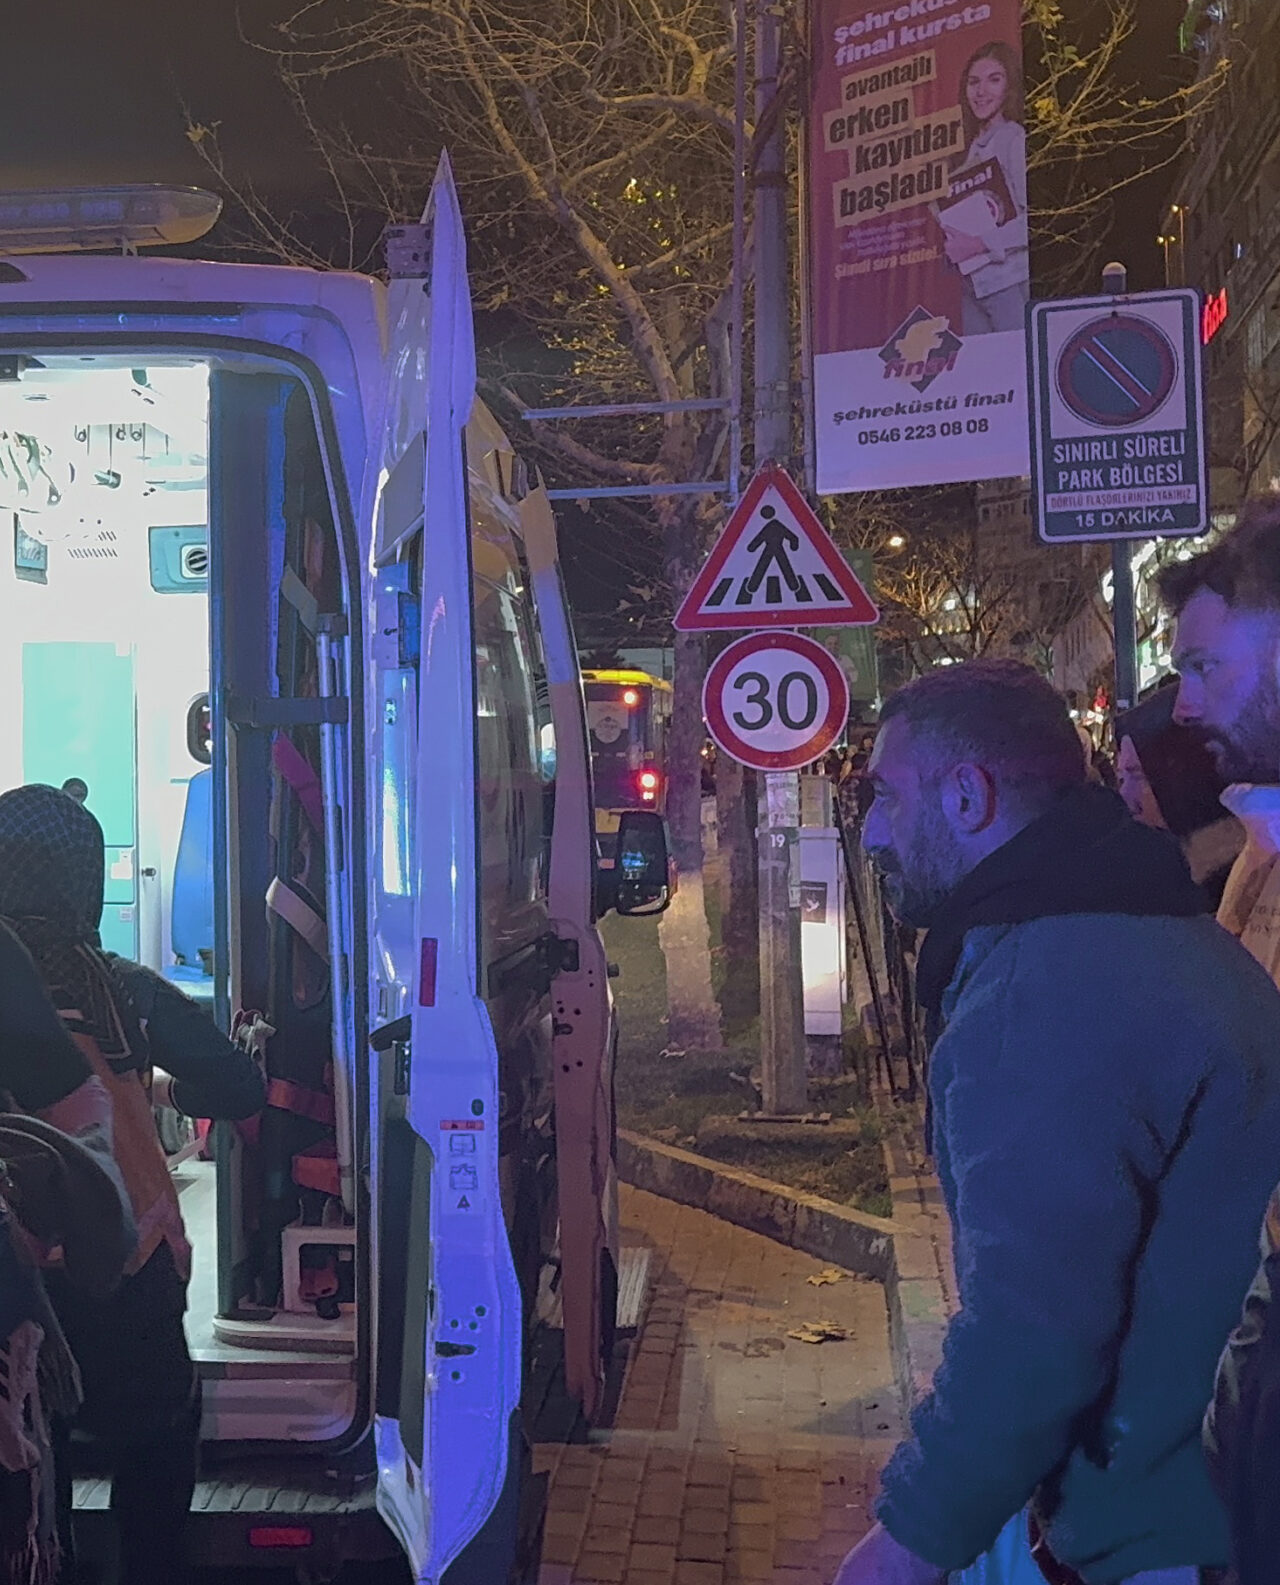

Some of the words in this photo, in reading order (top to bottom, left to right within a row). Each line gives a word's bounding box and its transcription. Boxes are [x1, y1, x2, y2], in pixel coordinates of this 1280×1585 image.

[834, 30, 895, 66] final
[900, 4, 991, 45] kursta
[845, 55, 932, 101] avantajlı
[829, 97, 909, 144] erken
[855, 118, 961, 174] kayıtlar
[839, 163, 942, 218] başladı
[883, 351, 959, 379] final
[833, 396, 958, 425] şehreküstü
[964, 389, 1015, 408] final
[858, 428, 901, 445] 0546
[904, 425, 936, 441] 223
[940, 421, 962, 437] 08
[966, 418, 989, 434] 08
[1053, 440, 1118, 464] SINIRLI
[1124, 432, 1185, 459] SÜRELİ
[1058, 468, 1104, 490] PARK
[1110, 460, 1183, 486] BÖLGESİ
[1076, 513, 1095, 528] 15
[1101, 506, 1175, 526] DAKİKA
[733, 671, 818, 731] 30
[770, 834, 786, 848] 19
